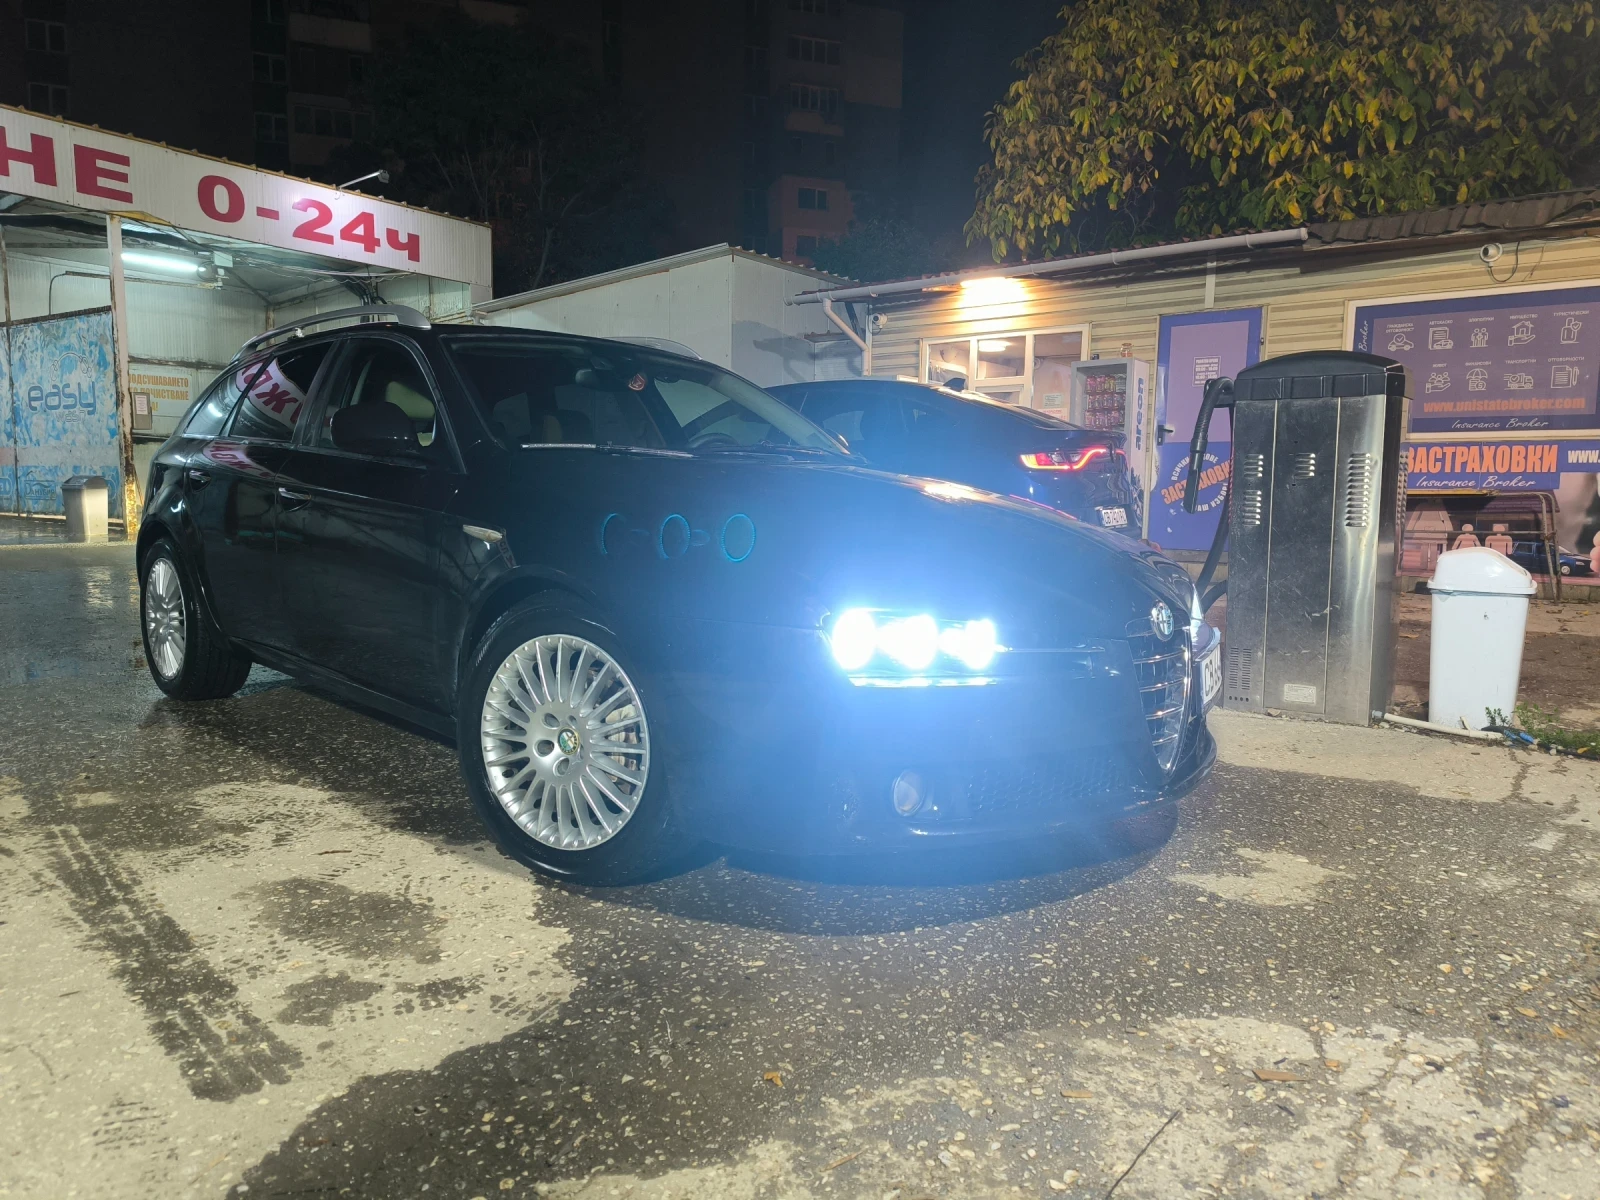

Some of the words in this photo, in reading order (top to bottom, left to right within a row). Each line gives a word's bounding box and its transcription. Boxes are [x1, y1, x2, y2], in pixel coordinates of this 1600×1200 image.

[0, 126, 133, 204] НЕ
[197, 174, 421, 263] 0-24ч
[1358, 320, 1369, 352] Broker
[28, 381, 97, 416] easy
[1135, 377, 1145, 451] areon
[1423, 396, 1586, 413] www.unistatebroker.com
[1451, 419, 1501, 429] Insurance
[1505, 418, 1549, 429] Broker
[1407, 444, 1559, 474] ЗАСТРАХОВКИ
[1416, 475, 1477, 488] Insurance
[1482, 475, 1537, 488] Broker
